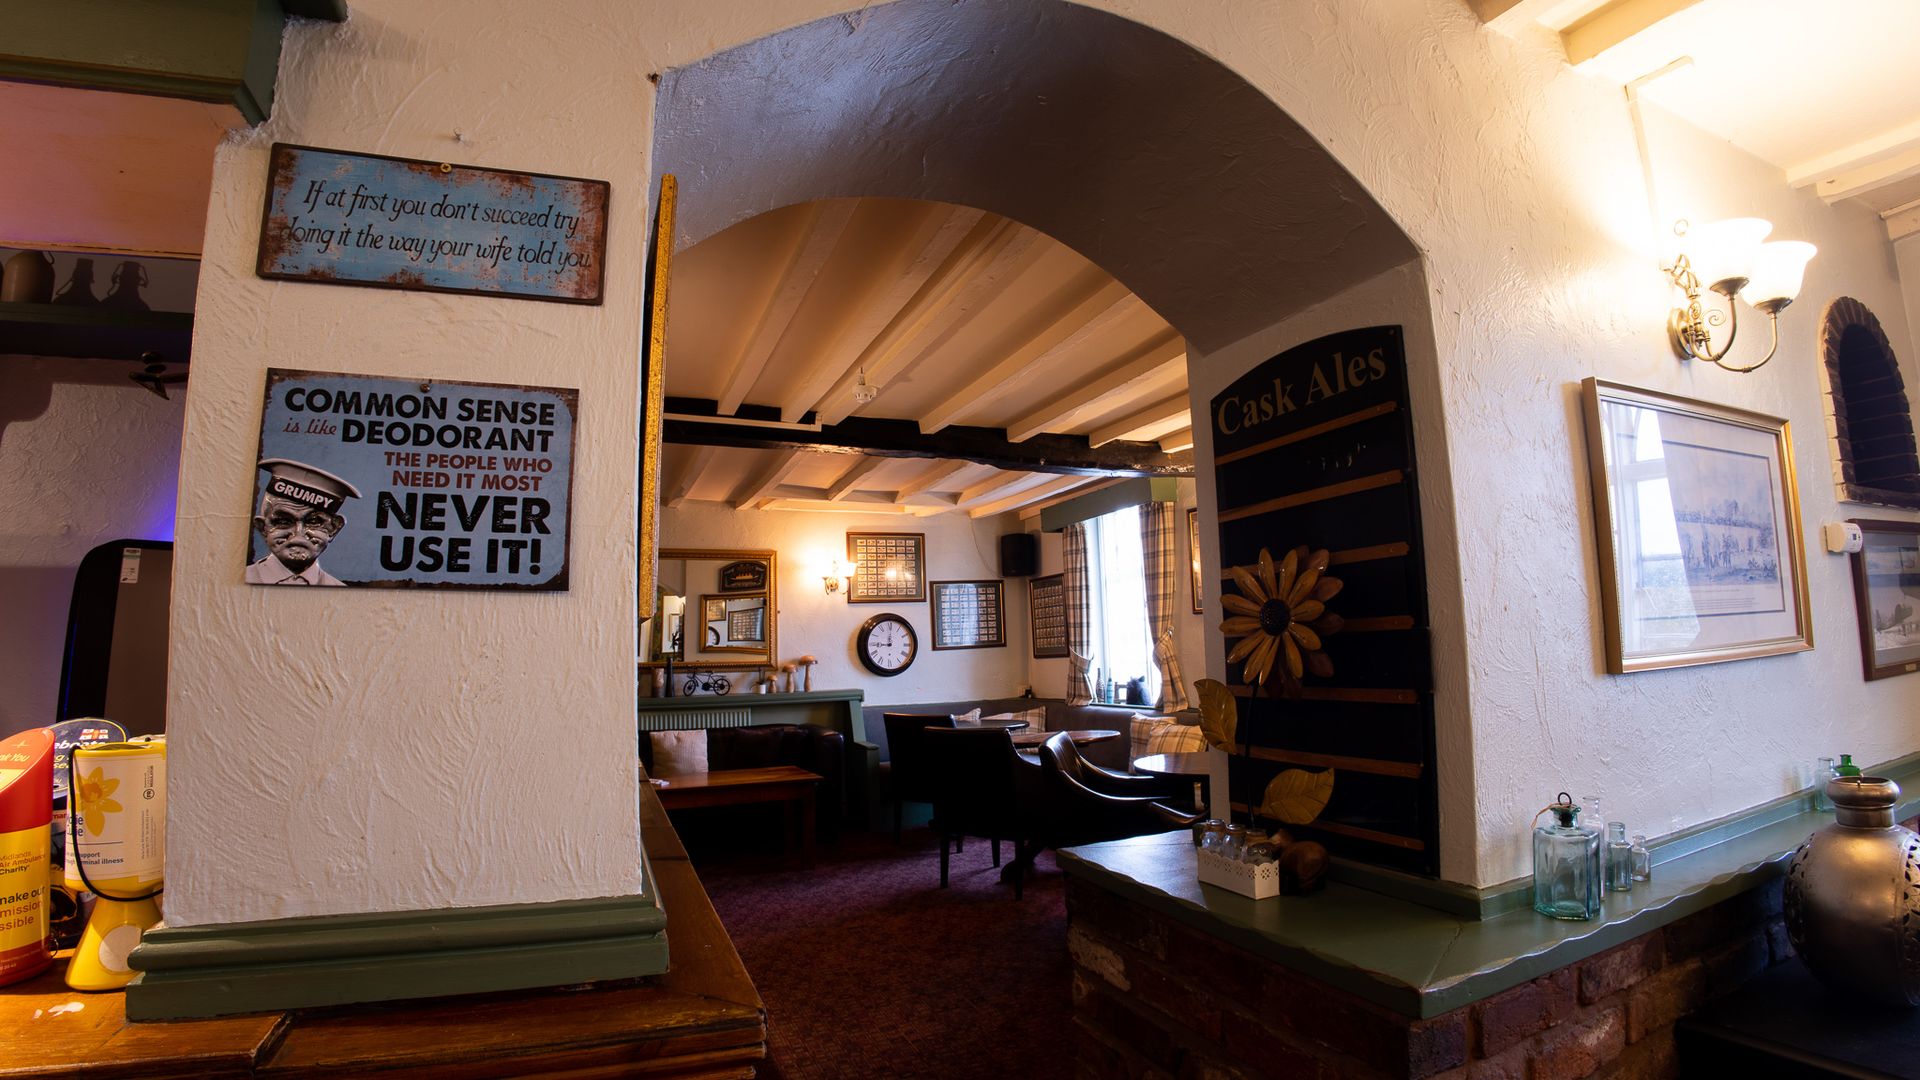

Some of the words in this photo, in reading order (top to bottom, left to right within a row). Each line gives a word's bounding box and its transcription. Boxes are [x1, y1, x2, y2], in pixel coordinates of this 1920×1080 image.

[303, 180, 326, 213] If
[326, 188, 345, 207] at
[347, 184, 388, 217] first
[389, 198, 426, 221] you
[431, 194, 479, 221] don't
[481, 205, 553, 228] succeed
[554, 211, 580, 238] try
[280, 216, 334, 253] doing
[337, 225, 352, 247] it
[355, 224, 384, 249] the
[388, 235, 427, 260] way
[428, 237, 472, 263] your
[476, 237, 513, 269] wife
[517, 241, 554, 265] told
[284, 387, 448, 420] COMMON
[456, 398, 555, 426] SENSE
[1218, 378, 1297, 435] Cask
[1305, 347, 1386, 406] Ales
[282, 417, 300, 434] is
[304, 419, 337, 435] like
[341, 419, 554, 452] DEODORANT
[384, 451, 421, 468] THE
[426, 454, 497, 471] PEOPLE
[503, 458, 553, 473] WHO
[392, 471, 450, 488] NEED
[456, 473, 476, 489] IT
[480, 474, 543, 491] MOST
[274, 481, 335, 510] GRUMPY
[376, 491, 551, 535] NEVER
[380, 535, 471, 573] USE
[486, 539, 542, 575] IT!
